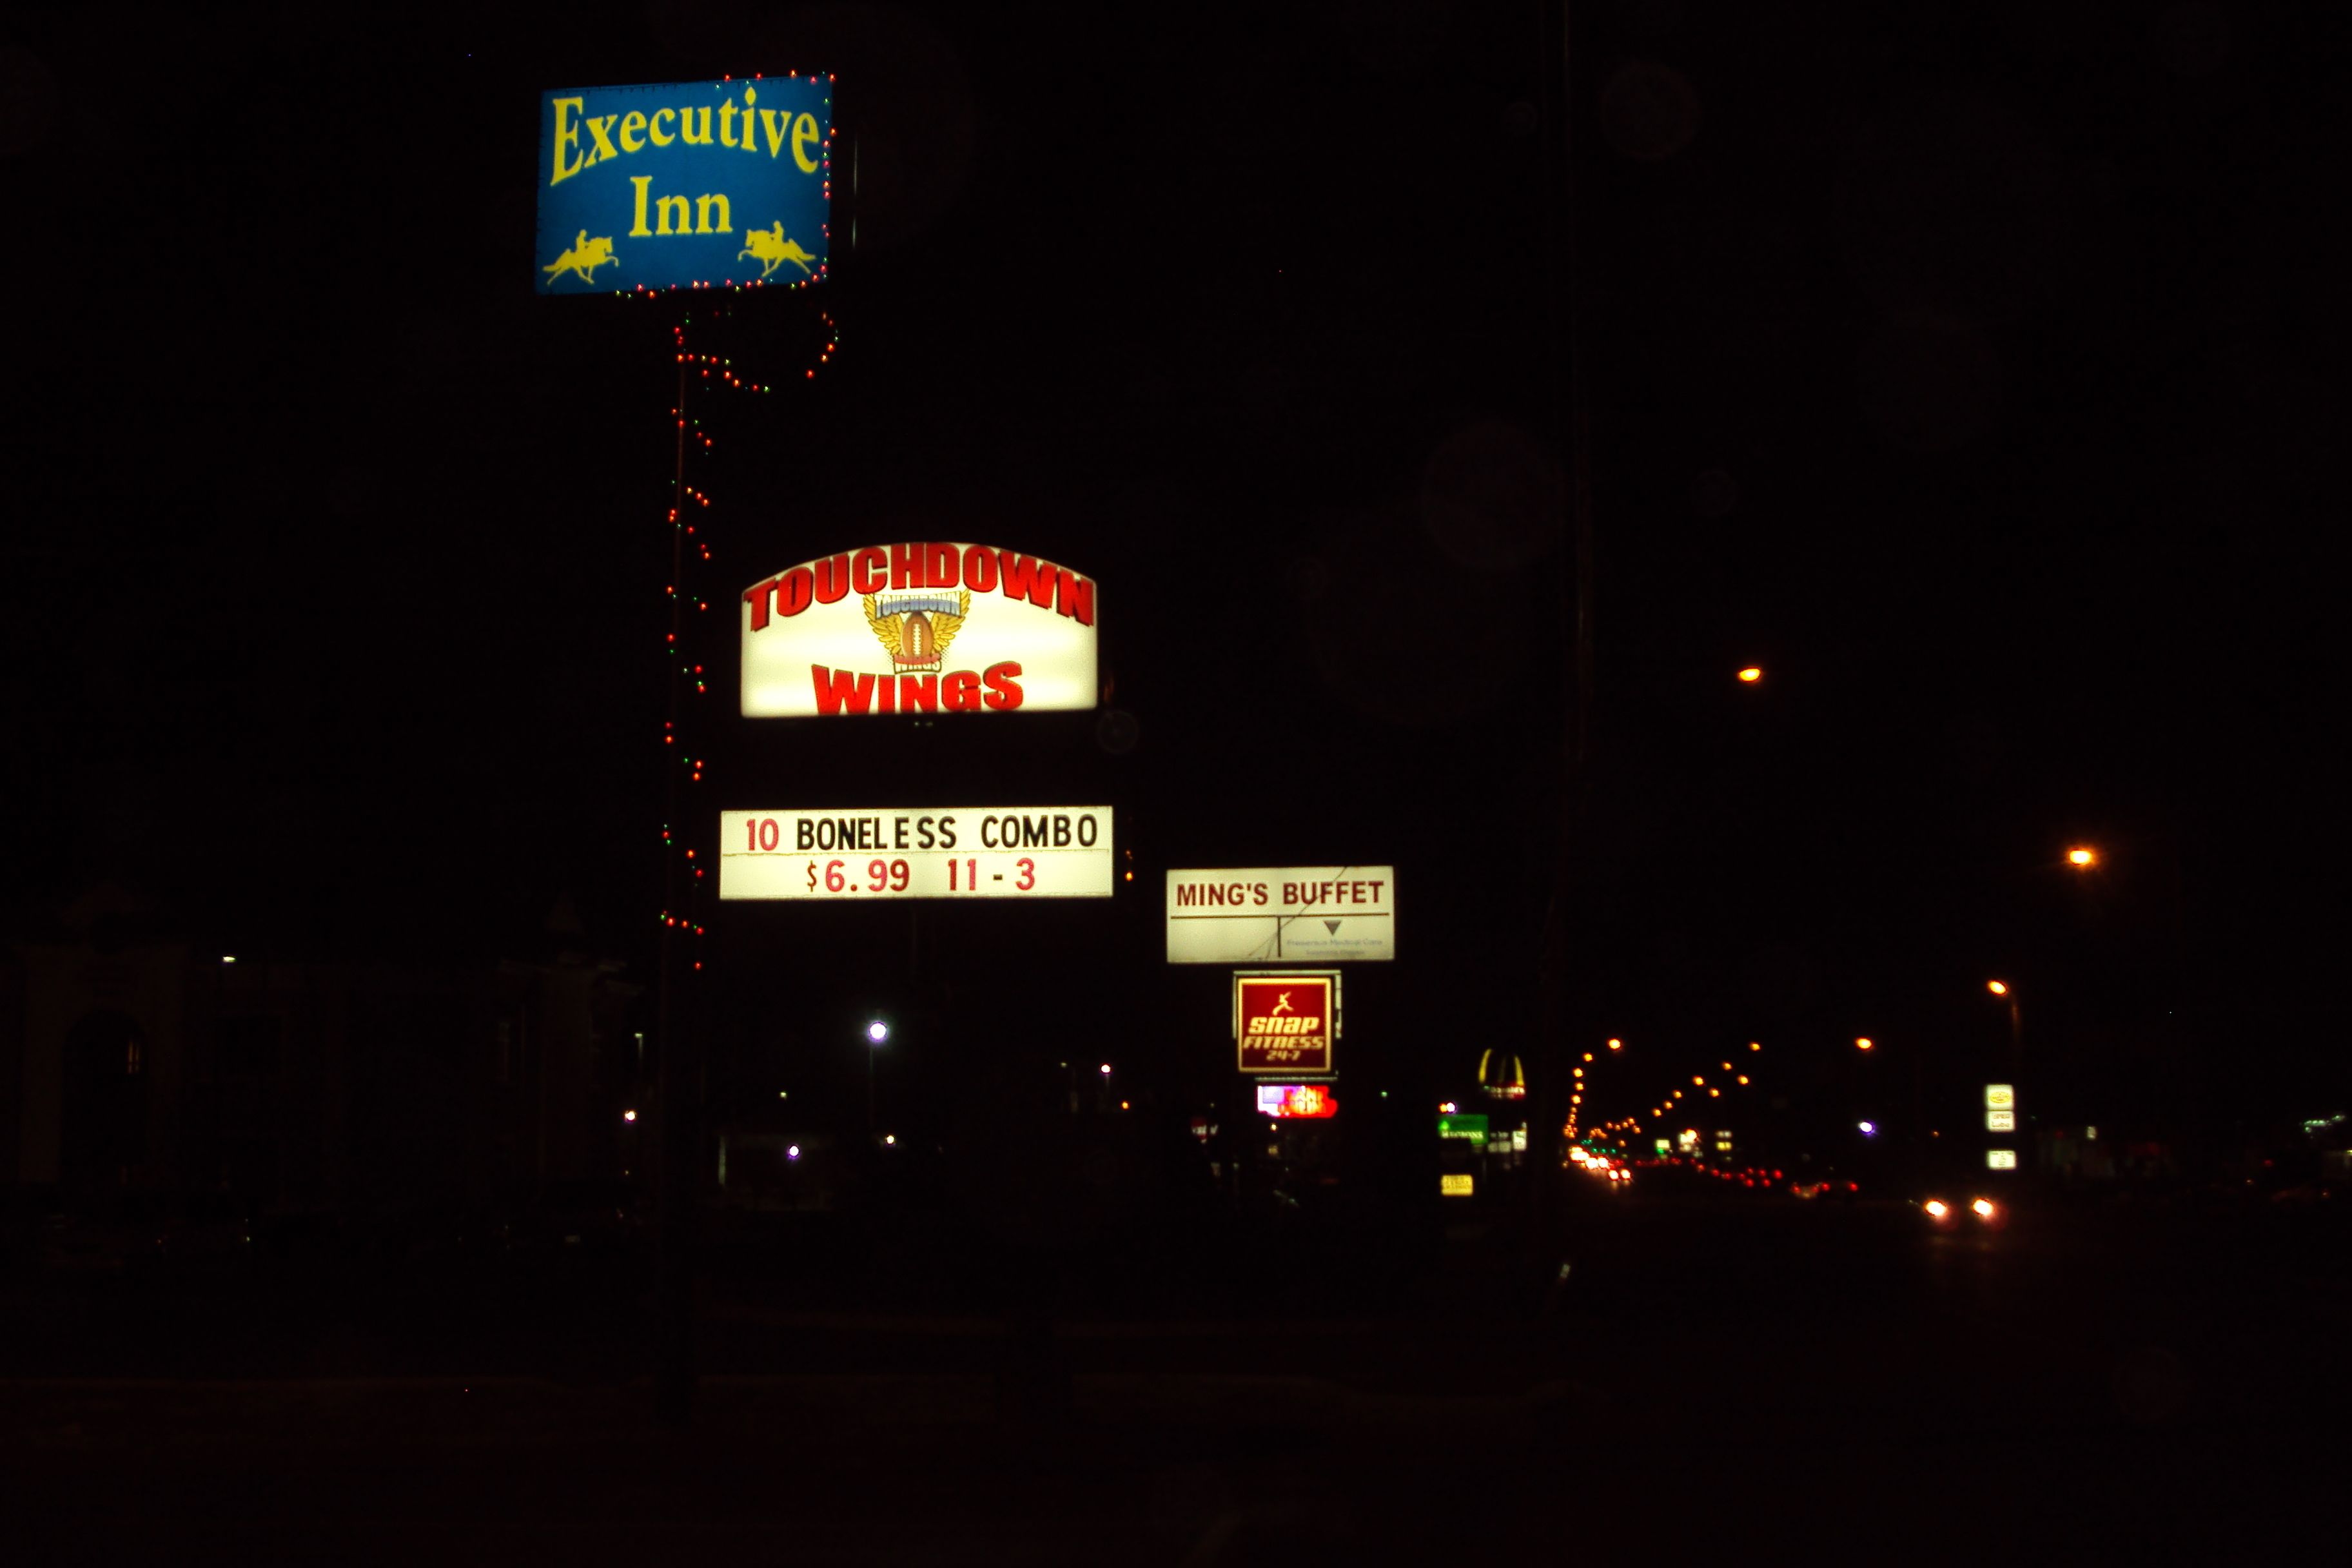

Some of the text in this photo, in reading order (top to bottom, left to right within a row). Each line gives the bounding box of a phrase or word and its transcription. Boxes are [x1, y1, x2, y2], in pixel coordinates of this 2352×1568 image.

[550, 86, 819, 186] Executive
[629, 175, 733, 237] Inn
[743, 542, 1095, 632] TOUCHDOWN
[874, 591, 961, 620] TOUCHDOWN
[811, 660, 1024, 716] WINGS
[746, 814, 1097, 851] 10 BONELESS COMBO
[807, 858, 910, 892] $6.99
[1177, 881, 1384, 906] MING'S BUFFET
[1243, 1035, 1325, 1050] FITNESS
